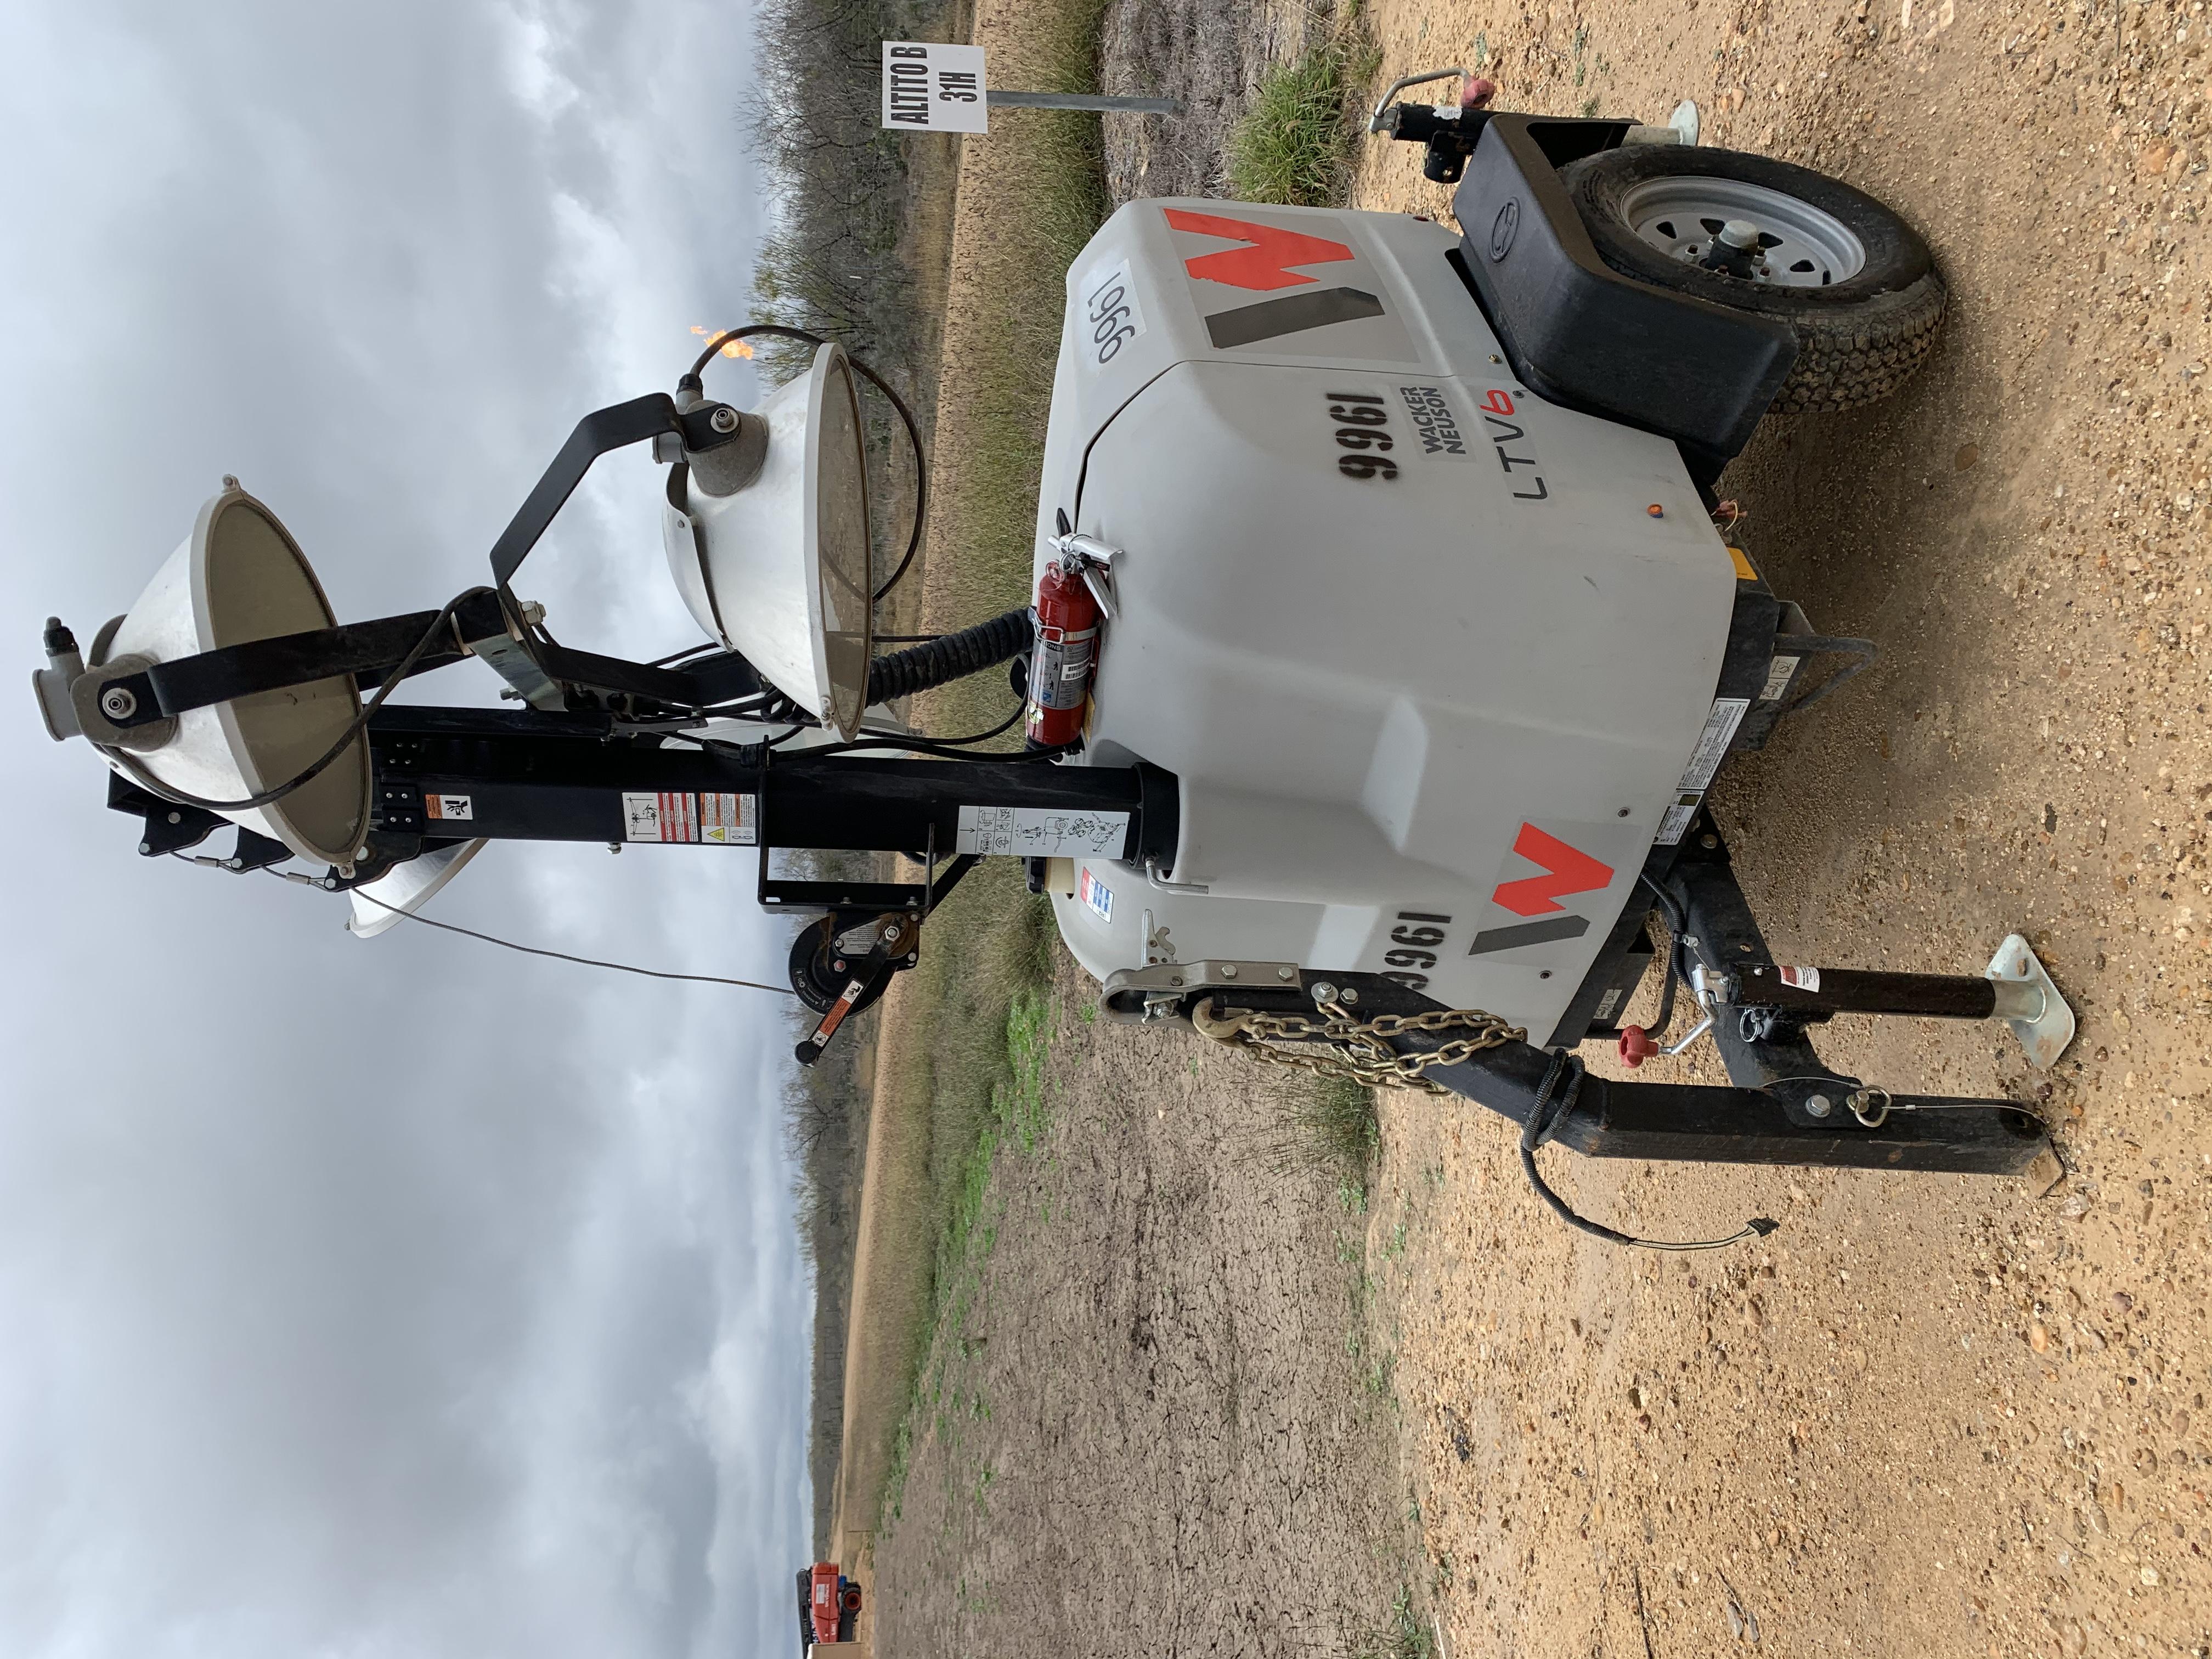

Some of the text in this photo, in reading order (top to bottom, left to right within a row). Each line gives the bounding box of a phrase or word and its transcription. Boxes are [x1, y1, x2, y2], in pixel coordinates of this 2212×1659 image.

[890, 46, 928, 125] ALTITO B
[939, 71, 977, 103] 31H
[1087, 272, 1135, 364] 9961
[1325, 392, 1398, 480] 9961
[1400, 386, 1443, 454] WACKER
[1419, 387, 1466, 455] NEUSON
[1479, 390, 1548, 500] LTV6
[1379, 911, 1453, 990] 9961
